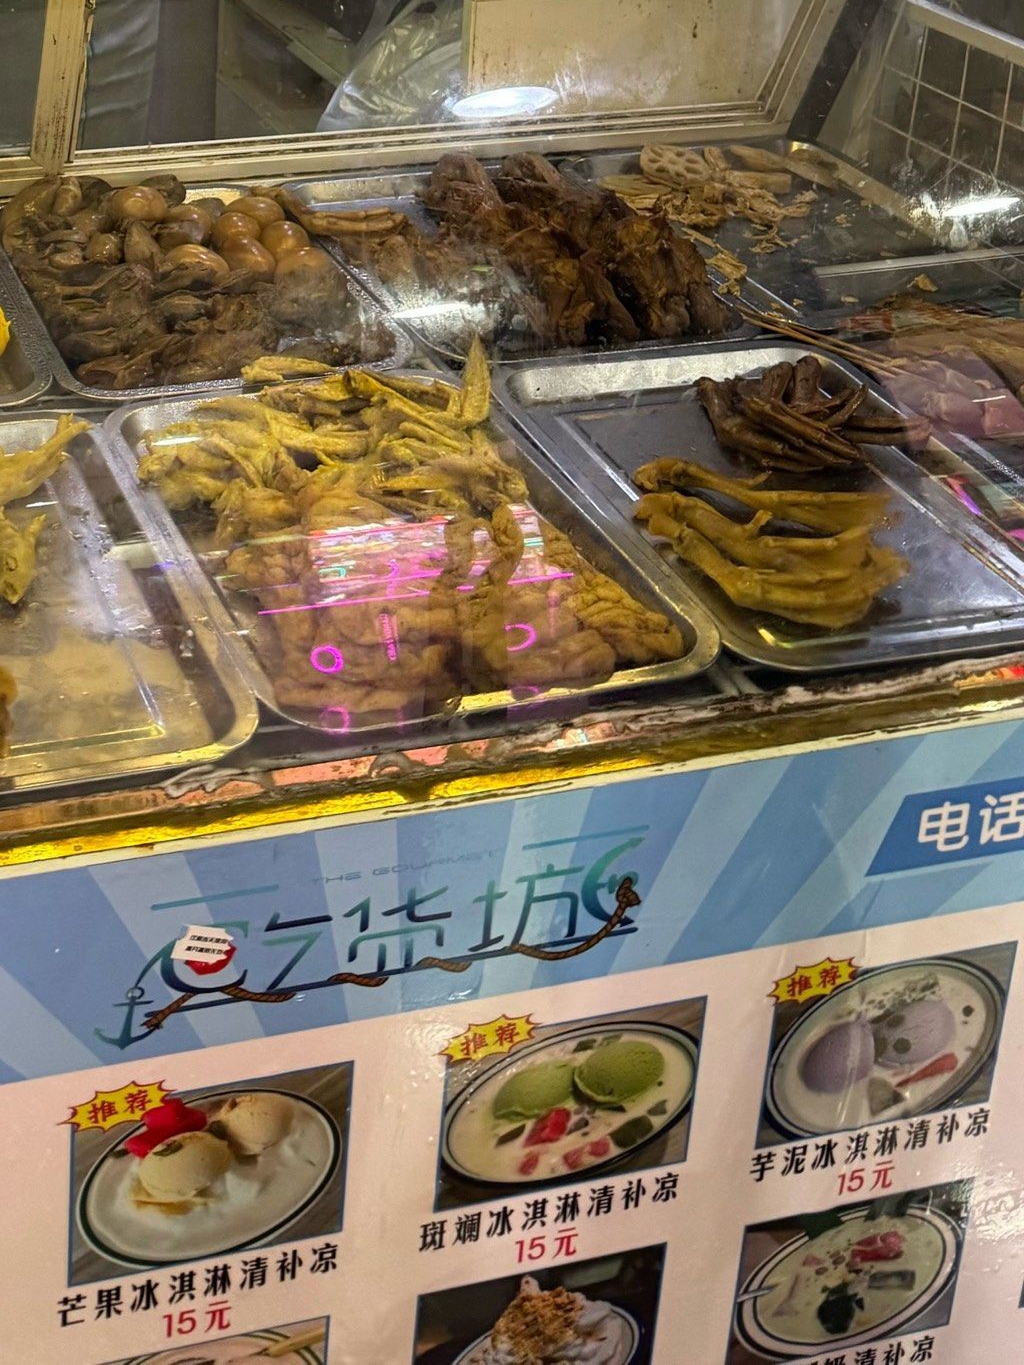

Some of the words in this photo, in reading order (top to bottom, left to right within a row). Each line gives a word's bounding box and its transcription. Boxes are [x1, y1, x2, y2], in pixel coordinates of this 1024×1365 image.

[917, 790, 1024, 852] 电话
[786, 964, 843, 997] 推荐
[459, 1021, 521, 1056] 推荐
[86, 1088, 154, 1124] 推荐
[748, 1107, 992, 1184] 芋泥冰淇淋清补凉
[836, 1159, 896, 1196] 15元
[418, 1171, 681, 1253] 斑斓冰淇淋清补凉
[514, 1226, 580, 1264] 15元
[56, 1241, 340, 1328] 芒果冰淇淋清补凉
[161, 1299, 233, 1339] 15元
[810, 1334, 935, 1365] 清补凉
